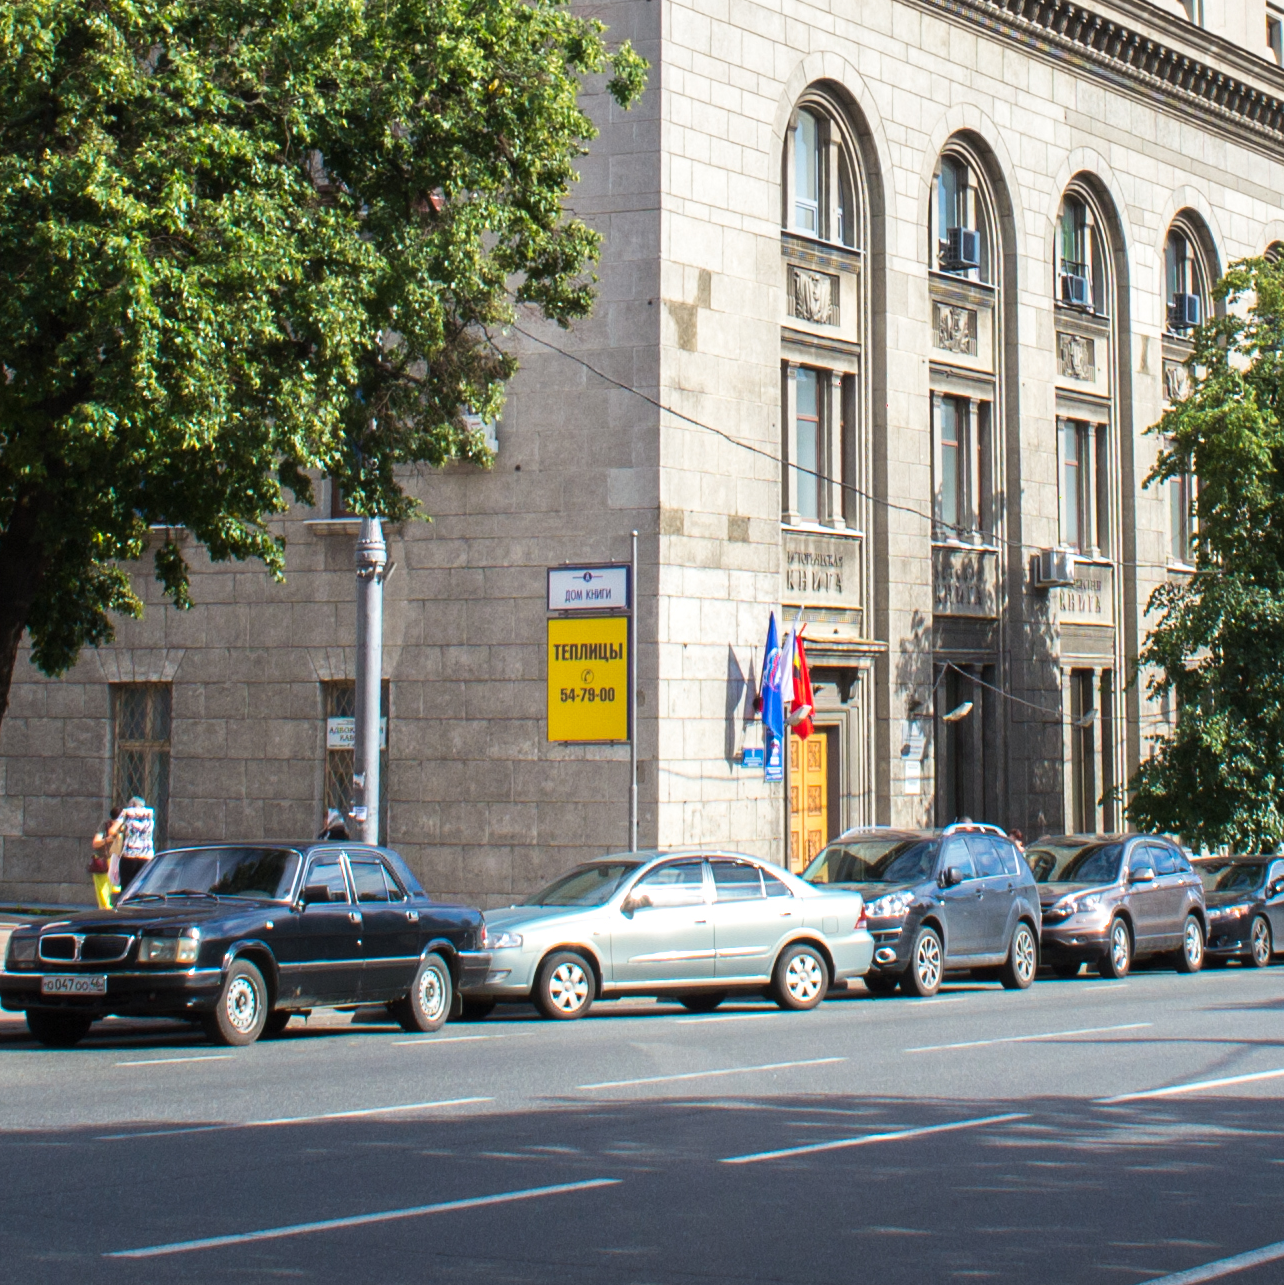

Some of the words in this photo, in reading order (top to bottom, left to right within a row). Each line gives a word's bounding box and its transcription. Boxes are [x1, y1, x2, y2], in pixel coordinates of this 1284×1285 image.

[787, 569, 843, 594] КНИГА
[565, 589, 583, 603] ДОМ
[585, 588, 612, 601] КНИГИ
[553, 642, 623, 663] ТЕПЛИЦЫ
[560, 687, 615, 703] 54-79-00
